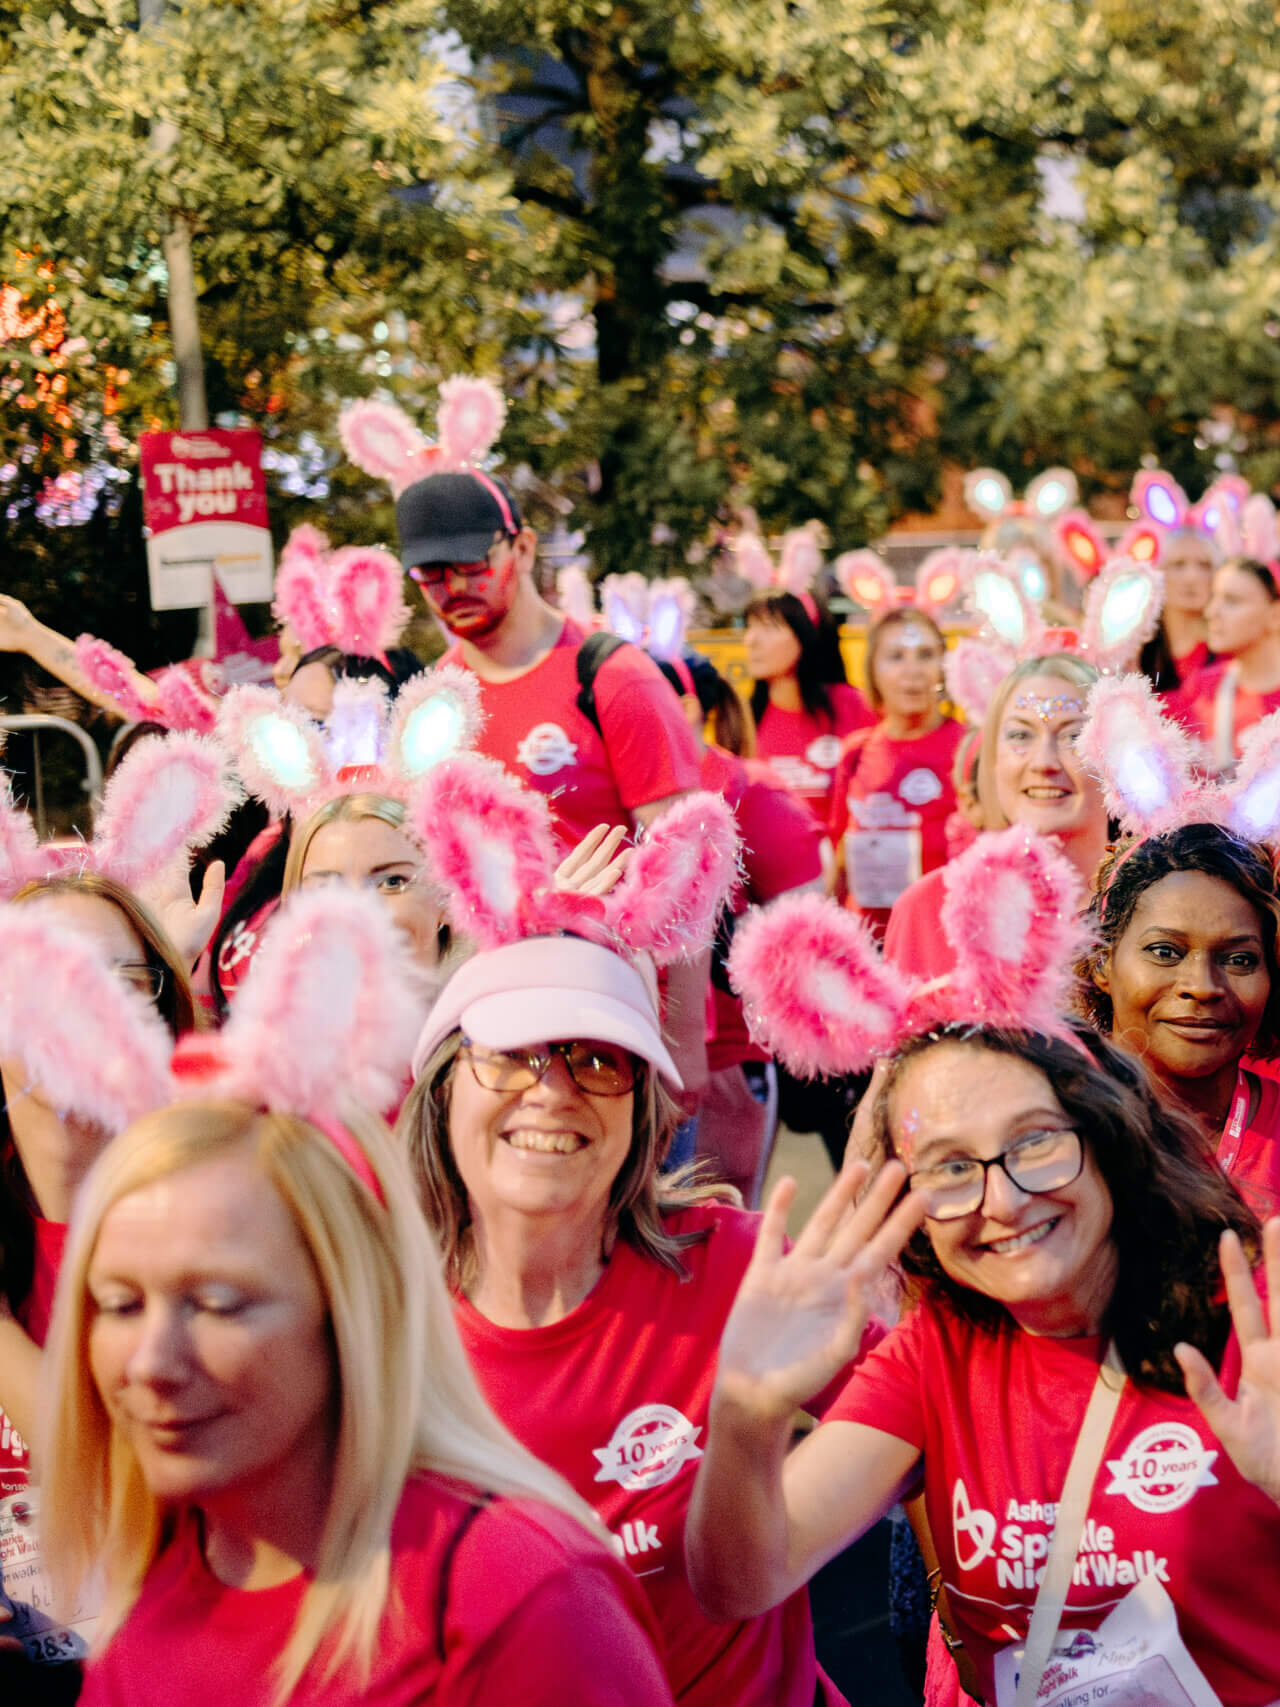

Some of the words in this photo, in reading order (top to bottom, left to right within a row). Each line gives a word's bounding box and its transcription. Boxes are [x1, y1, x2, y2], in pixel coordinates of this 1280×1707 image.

[153, 460, 254, 493] Thank
[176, 491, 237, 523] you
[616, 1442, 645, 1467] 10
[649, 1435, 688, 1457] years
[1128, 1458, 1157, 1479] 10
[1161, 1460, 1198, 1477] years
[1007, 1499, 1060, 1525] Ashg
[611, 1520, 662, 1556] alk
[1001, 1519, 1114, 1568] Sple
[996, 1556, 1090, 1590] Nit
[1090, 1550, 1170, 1587] Walk
